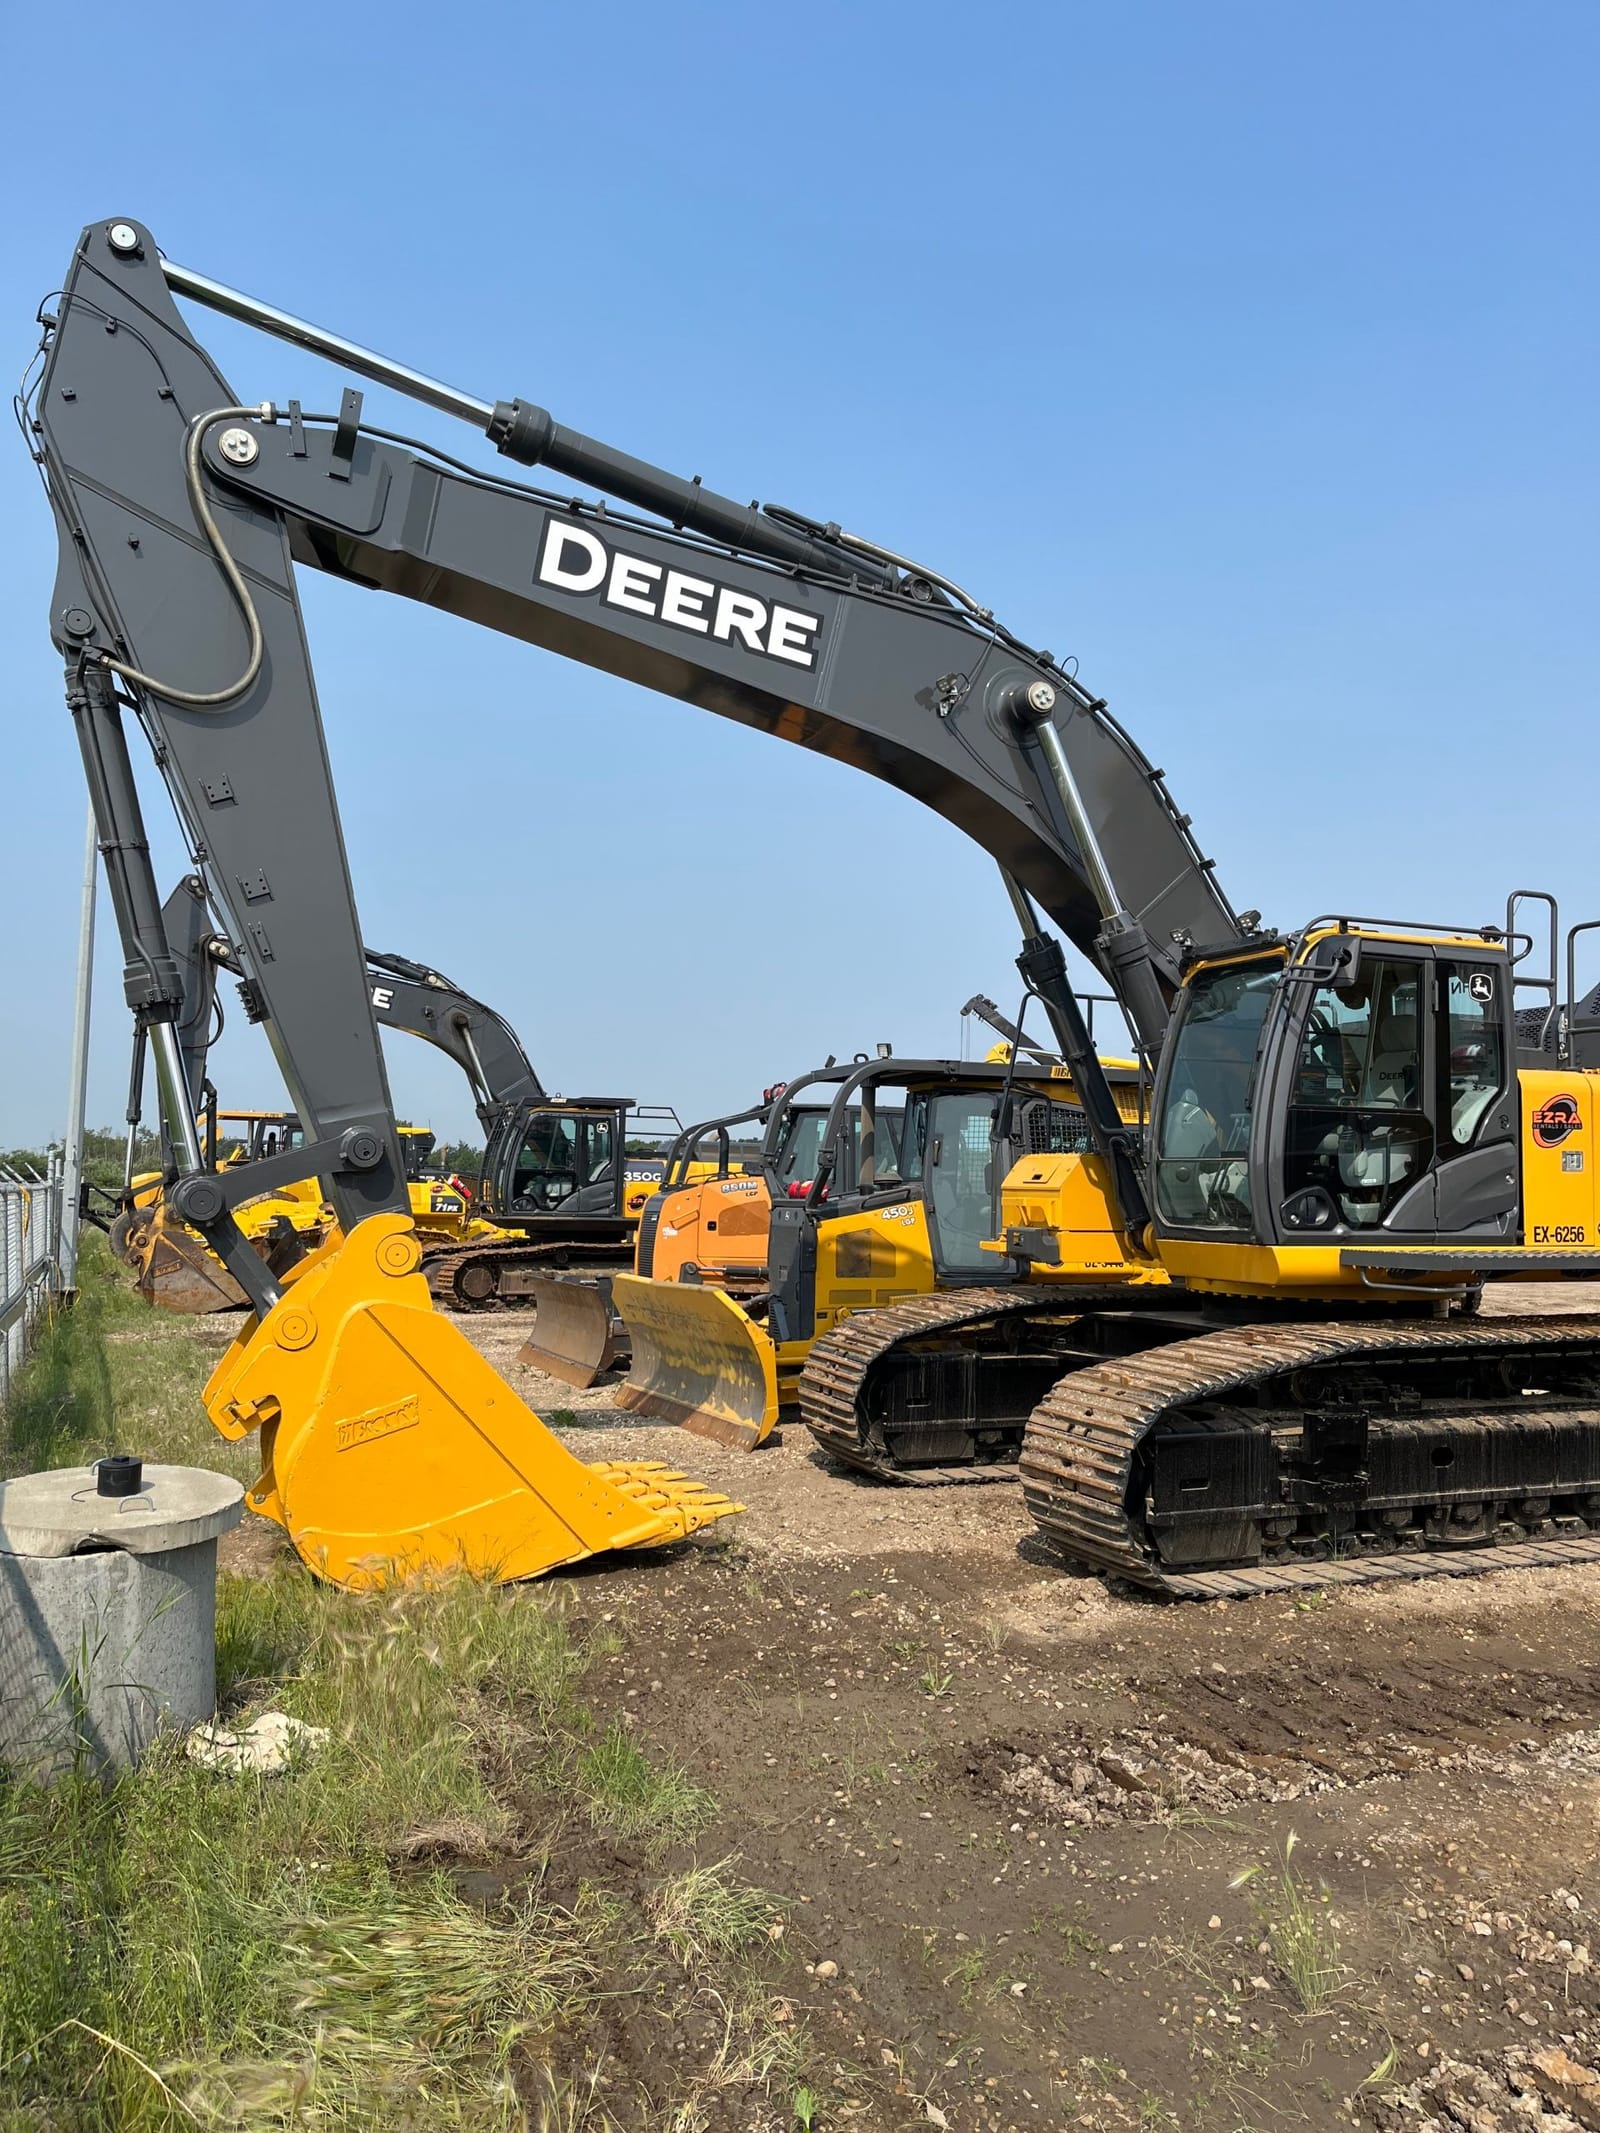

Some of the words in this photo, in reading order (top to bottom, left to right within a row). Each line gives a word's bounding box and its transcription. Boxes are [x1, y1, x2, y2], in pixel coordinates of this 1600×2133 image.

[539, 519, 818, 667] DEERE
[1533, 1111, 1581, 1124] EZRA
[624, 1171, 662, 1181] 350G
[881, 1205, 914, 1219] 450J
[1534, 1226, 1585, 1243] EX-6256
